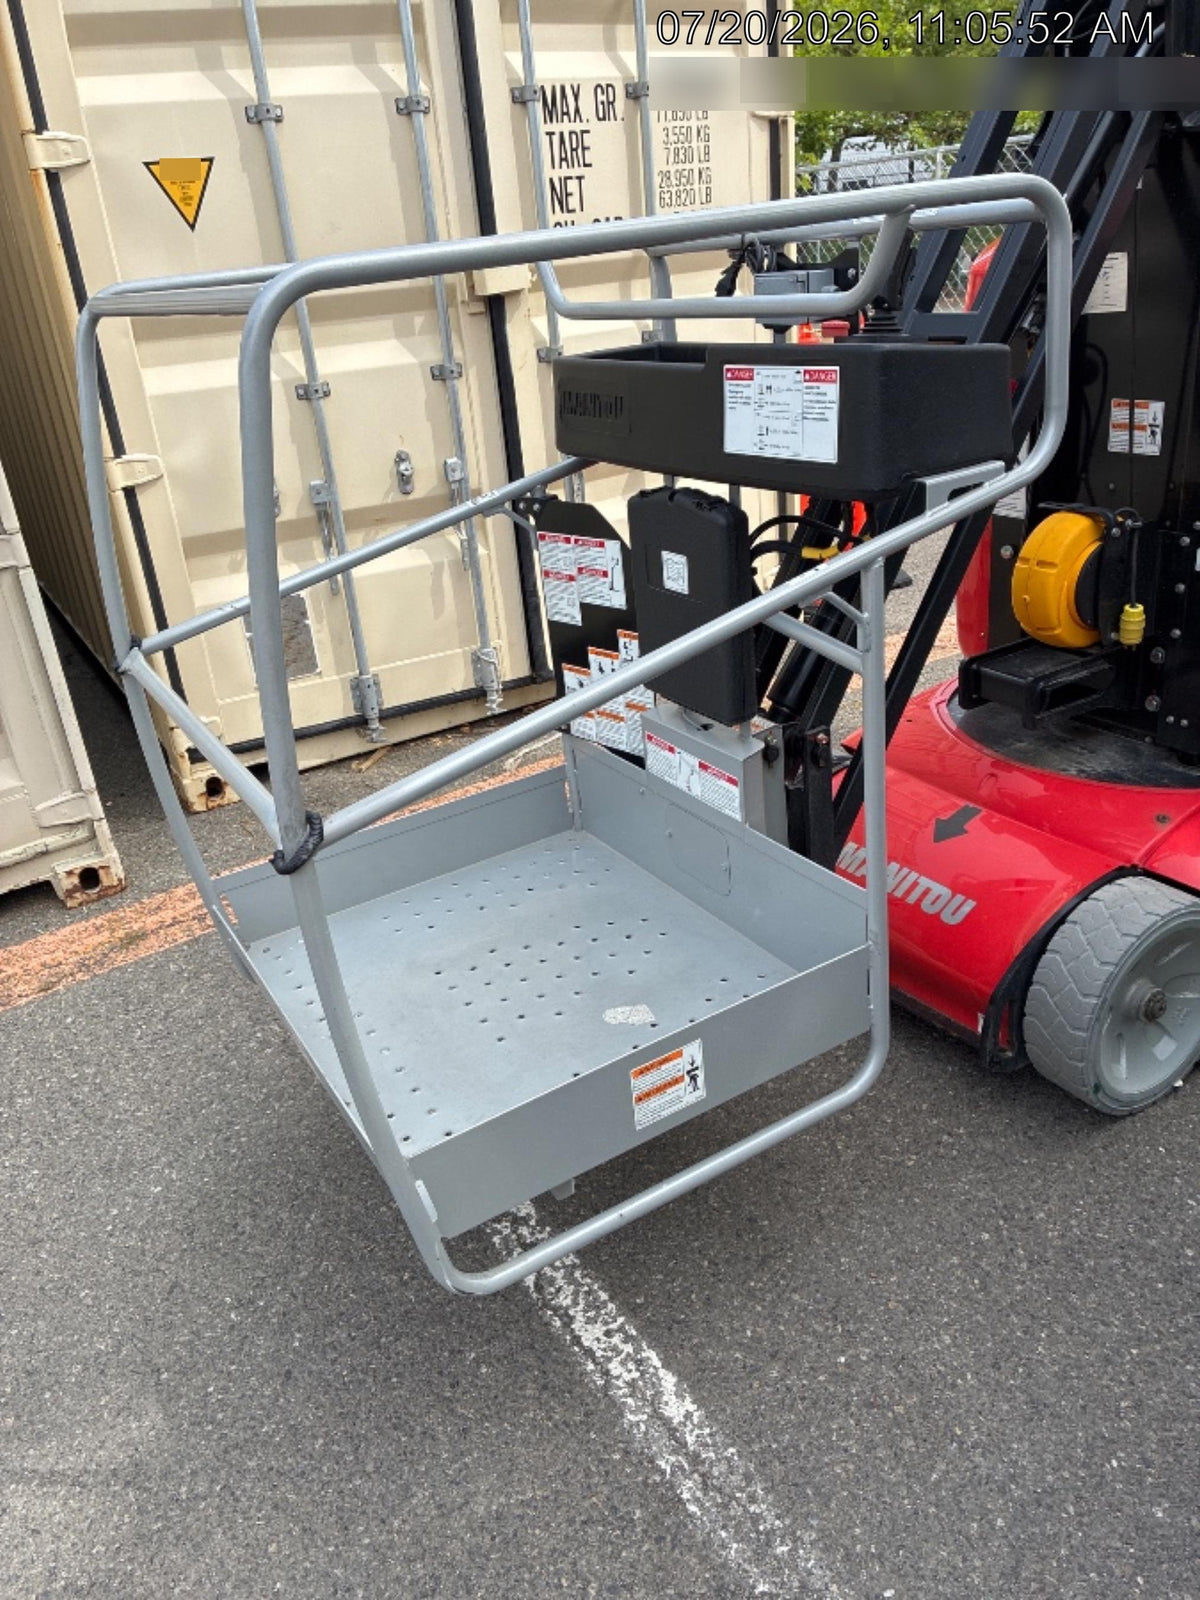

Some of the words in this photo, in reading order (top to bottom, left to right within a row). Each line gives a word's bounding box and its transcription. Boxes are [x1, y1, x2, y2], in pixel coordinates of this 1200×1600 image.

[540, 83, 590, 125] MAX.
[594, 83, 625, 122] GR.
[662, 125, 693, 146] 3,550
[696, 124, 710, 144] KG
[545, 130, 593, 169] TARE
[663, 145, 694, 165] 7,830
[697, 144, 710, 163] LB
[698, 166, 712, 186] KG
[549, 175, 585, 215] NET
[658, 188, 696, 209] 63,820
[698, 186, 712, 206] LB
